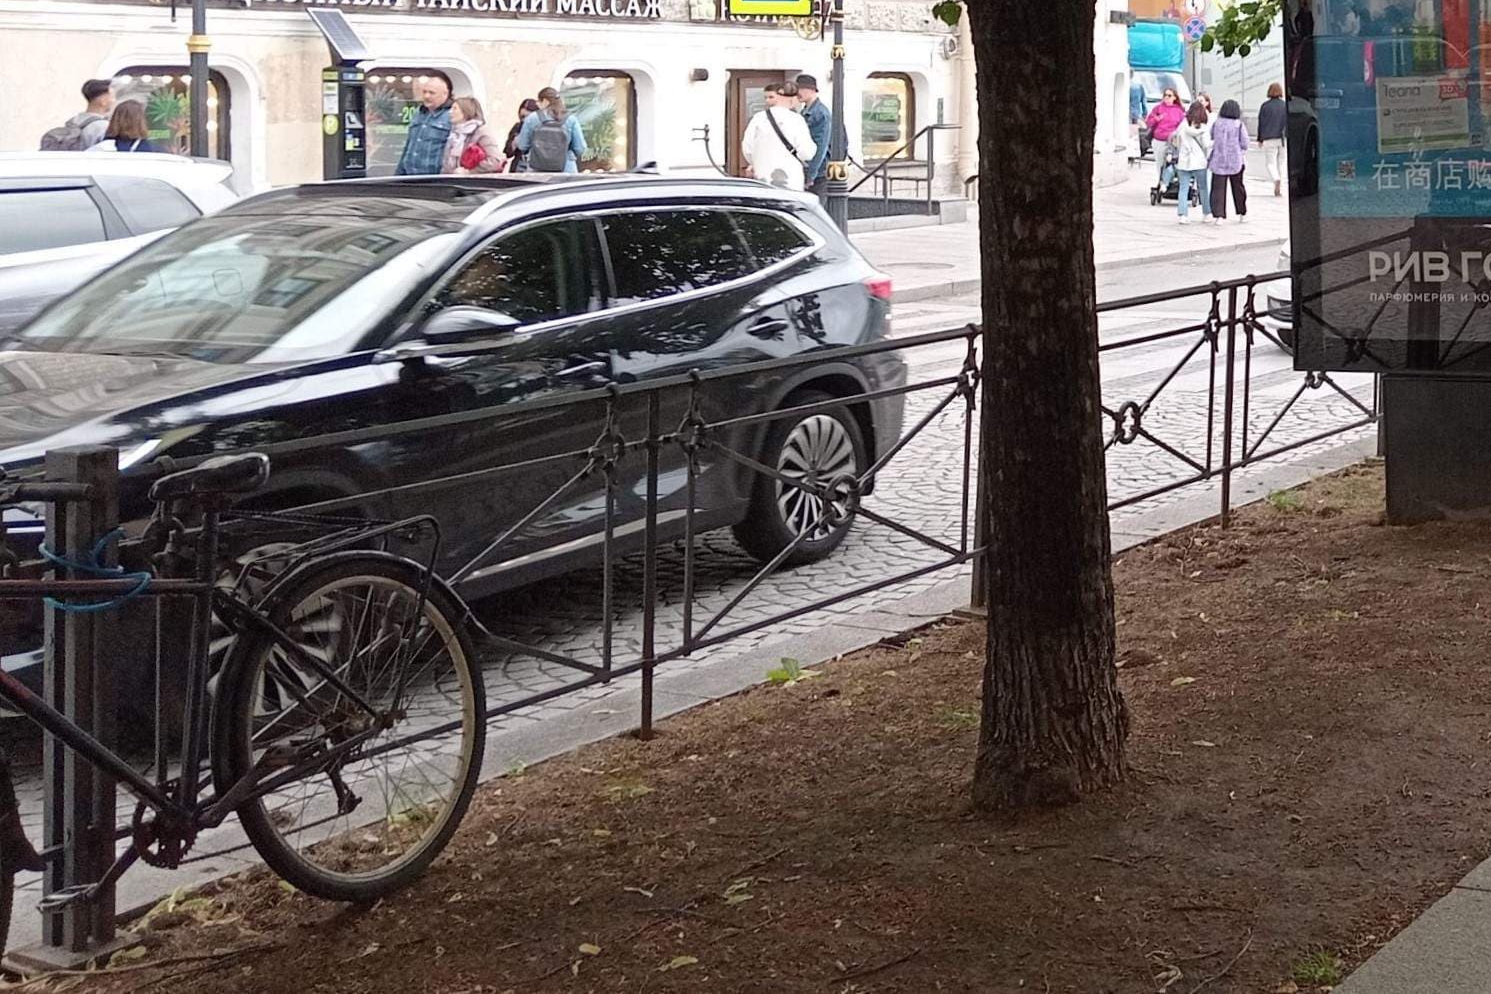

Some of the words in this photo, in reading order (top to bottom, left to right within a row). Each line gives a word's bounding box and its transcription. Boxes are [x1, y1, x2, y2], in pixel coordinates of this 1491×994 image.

[1369, 251, 1450, 282] РИВ
[1369, 292, 1455, 303] ПАРФЮМЕРИЯ
[1459, 293, 1469, 303] И
